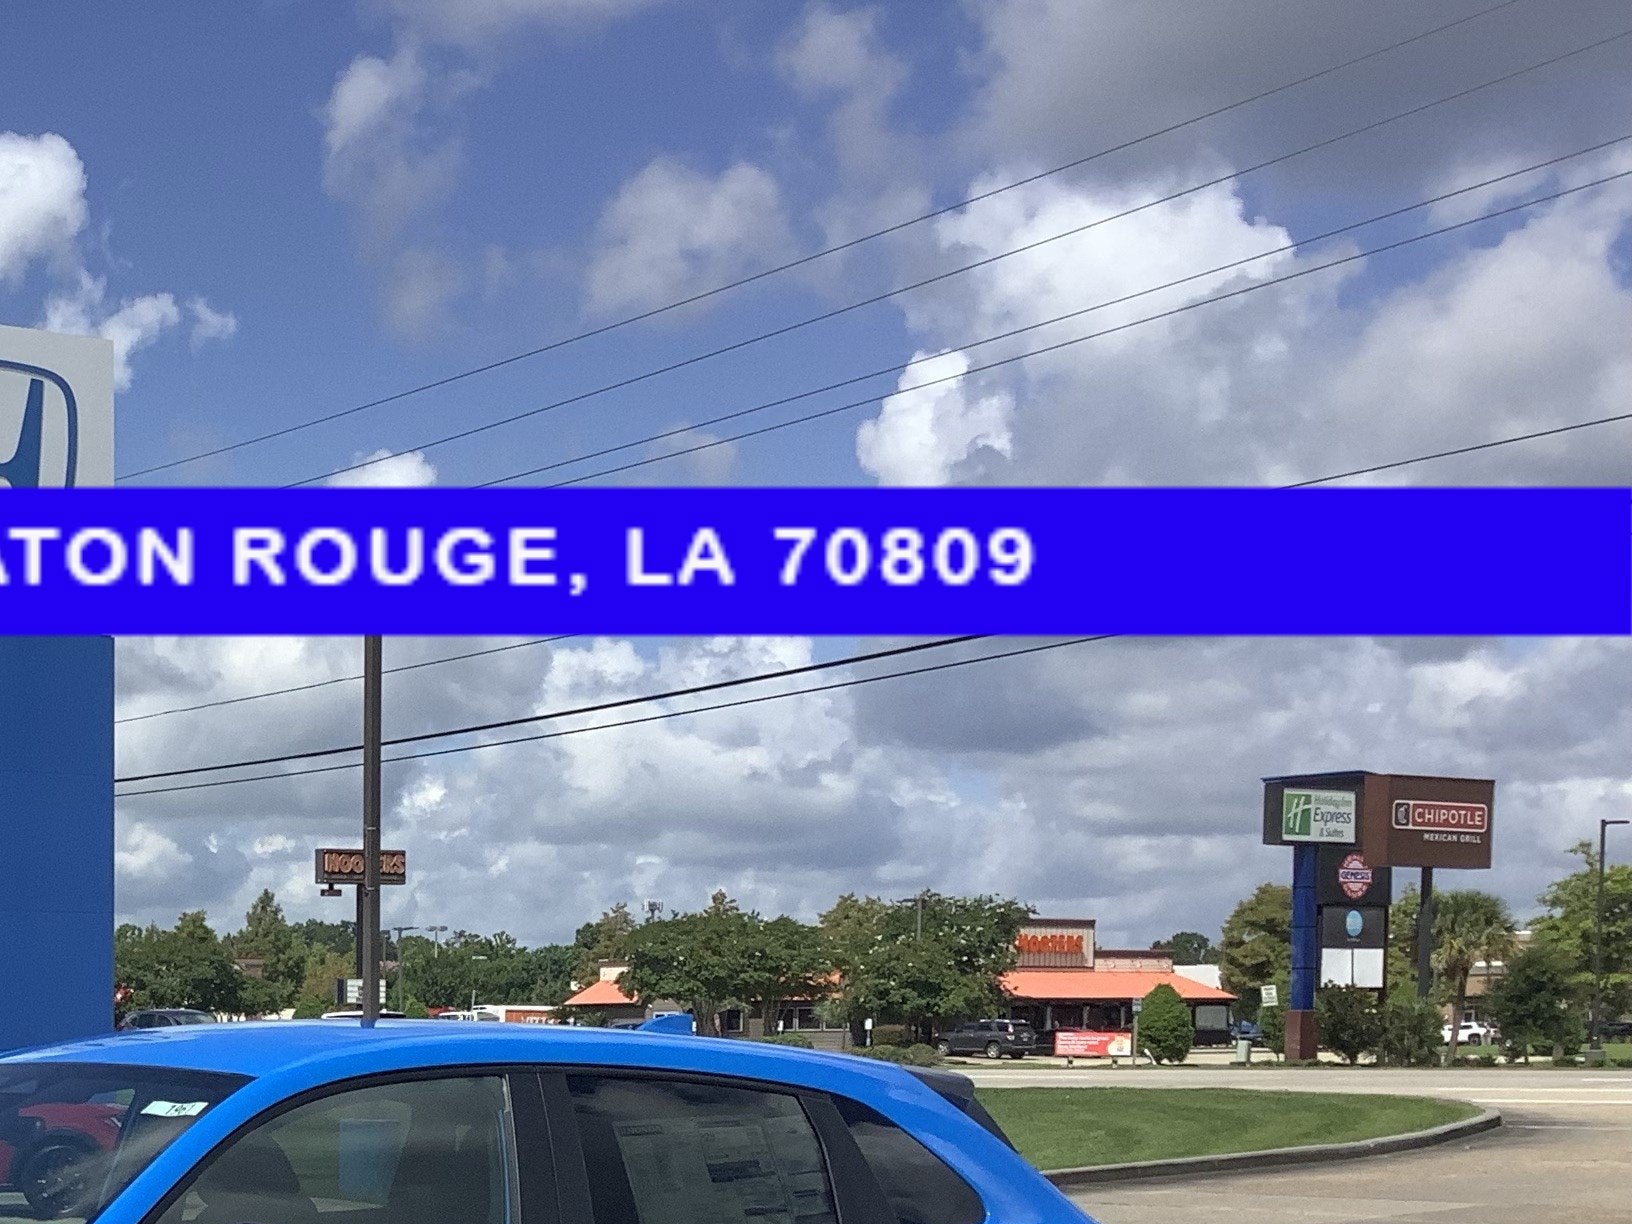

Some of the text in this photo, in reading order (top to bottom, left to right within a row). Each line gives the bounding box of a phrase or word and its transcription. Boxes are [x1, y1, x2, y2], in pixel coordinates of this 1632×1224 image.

[1313, 807, 1352, 826] Express
[1414, 808, 1484, 825] CHIPOTLE
[1423, 833, 1482, 844] MEXICAN GRILL
[324, 852, 405, 874] HOORS
